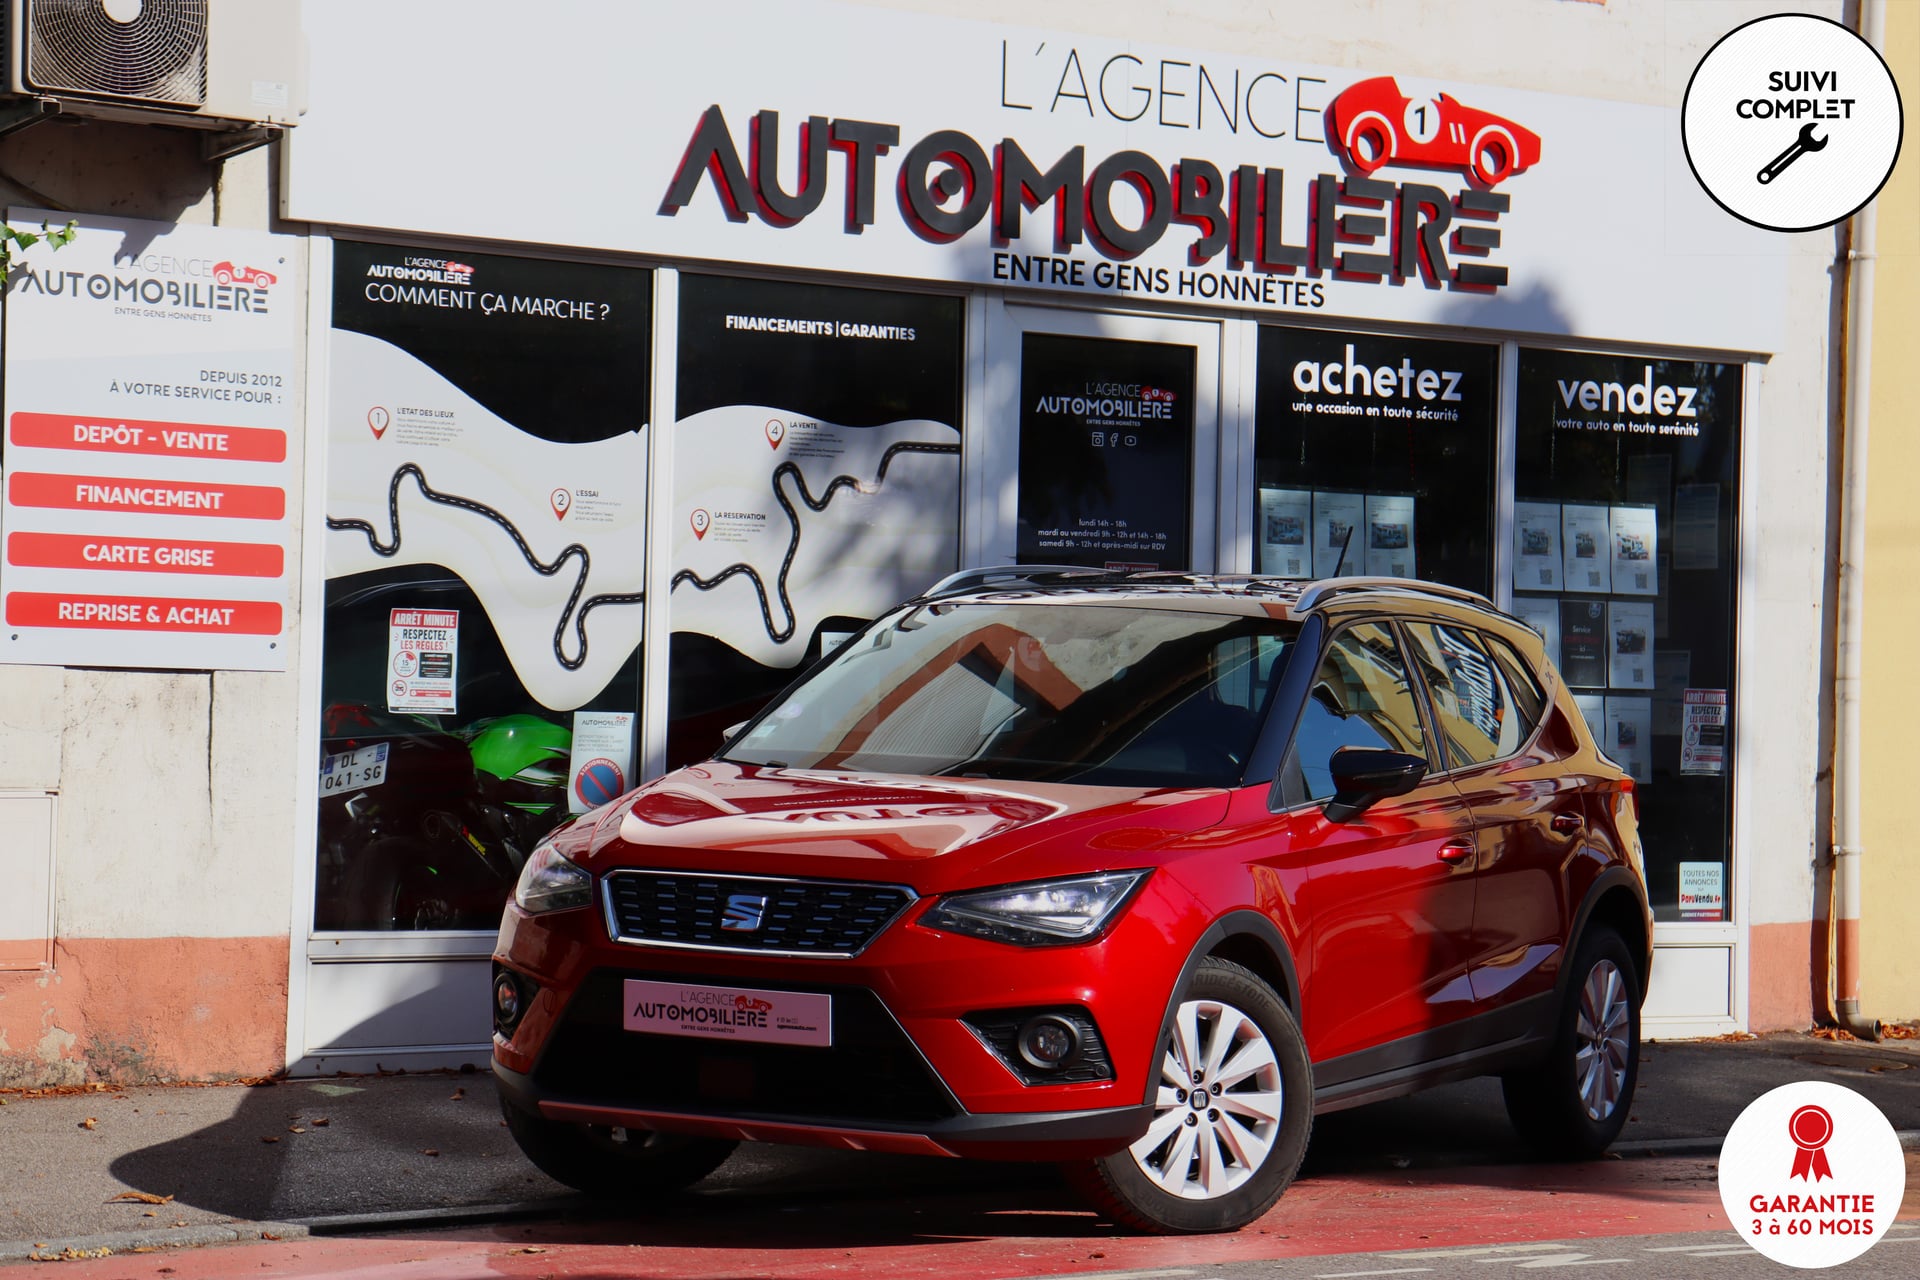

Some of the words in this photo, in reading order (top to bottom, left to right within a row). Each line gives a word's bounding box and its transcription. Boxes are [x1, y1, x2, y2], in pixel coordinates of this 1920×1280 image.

[1001, 39, 1326, 144] L'AGENCE
[993, 253, 1085, 286] ENTRE
[1092, 261, 1171, 294] GENS
[1177, 271, 1325, 307] HONNÊTES
[365, 282, 476, 309] COMMENT
[480, 292, 507, 316] ÇA
[511, 295, 595, 321] MARCHE
[599, 303, 611, 321] ?
[114, 306, 141, 317] ENTRE
[143, 308, 166, 319] GENS
[725, 315, 833, 336] FINANCEMENTS
[840, 323, 916, 342] GARANTIES
[200, 370, 248, 385] DEPUIS
[251, 374, 283, 388] 2012
[1292, 343, 1463, 401] achetez
[109, 379, 120, 393] À
[123, 382, 171, 397] VOTRE
[174, 385, 231, 401] SERVICE
[234, 390, 273, 404] POUR
[1085, 382, 1141, 398] L'AGENCE
[1557, 365, 1698, 417] vendez
[419, 409, 433, 417] DES
[434, 410, 455, 418] LIEUX
[1292, 402, 1313, 413] une
[1316, 401, 1363, 416] occasion
[1366, 406, 1380, 417] en
[1383, 405, 1412, 419] toute
[1415, 406, 1459, 422] sécurité
[771, 425, 778, 435] 4
[789, 421, 798, 429] LA
[799, 422, 817, 430] VENTE
[1556, 418, 1583, 430] votre
[1586, 419, 1610, 431] auto
[1612, 421, 1626, 433] en
[1628, 421, 1656, 434] toute
[73, 423, 144, 447] DEPÔT
[161, 430, 229, 452] VENTE
[75, 484, 225, 510] FINANCEMENT
[557, 493, 565, 506] 2
[696, 514, 704, 526] 3
[714, 511, 723, 519] LA
[1078, 518, 1096, 527] lundi
[1097, 519, 1109, 527] 14h
[1115, 520, 1127, 528] 18h
[1037, 528, 1059, 537] mardi
[1070, 529, 1100, 538] vendredi
[1116, 531, 1128, 539] 12h
[1137, 531, 1149, 539] 14h
[1039, 539, 1065, 548] samedi
[1065, 539, 1075, 548] 9h
[1081, 540, 1092, 548] 12h
[1093, 541, 1101, 549] et
[1151, 543, 1166, 551] RDV
[82, 543, 150, 564] CARTE
[153, 546, 214, 567] GRISE
[58, 602, 142, 623] REPRISE
[145, 605, 161, 623] &
[165, 606, 235, 626] ACHAT
[394, 611, 422, 625] ARRÊT
[423, 613, 456, 627] MINUTE
[402, 628, 447, 641] RESPECTEZ
[400, 639, 414, 650] LES
[340, 752, 359, 769] DL
[325, 765, 382, 790] 041-SG
[1683, 870, 1706, 878] TOUTES
[1706, 870, 1720, 878] NOS
[1684, 878, 1718, 886] ANNONCES
[680, 990, 736, 1007] L'AGENCE
[681, 1023, 696, 1031] ENTRE
